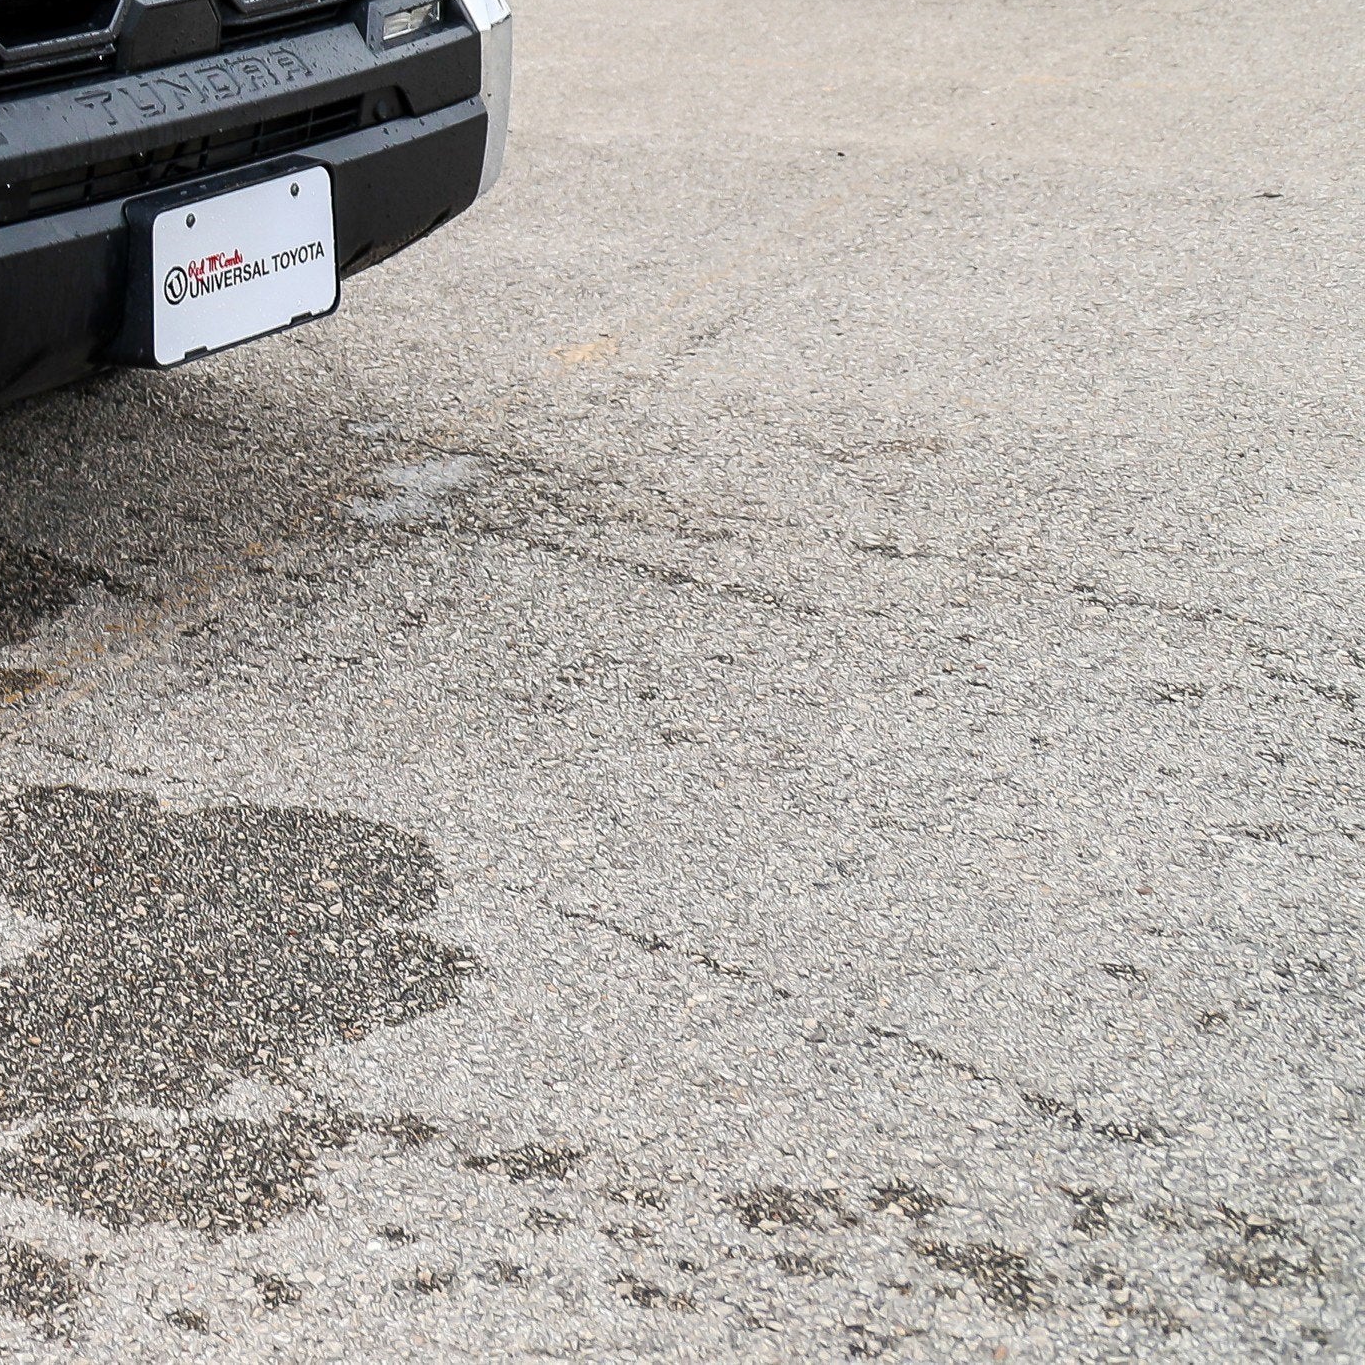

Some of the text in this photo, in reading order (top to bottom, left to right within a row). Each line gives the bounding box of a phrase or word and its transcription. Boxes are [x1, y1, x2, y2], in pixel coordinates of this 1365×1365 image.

[74, 46, 312, 127] TUNDRA
[189, 240, 325, 299] UNIVERSAL TOYOTA
